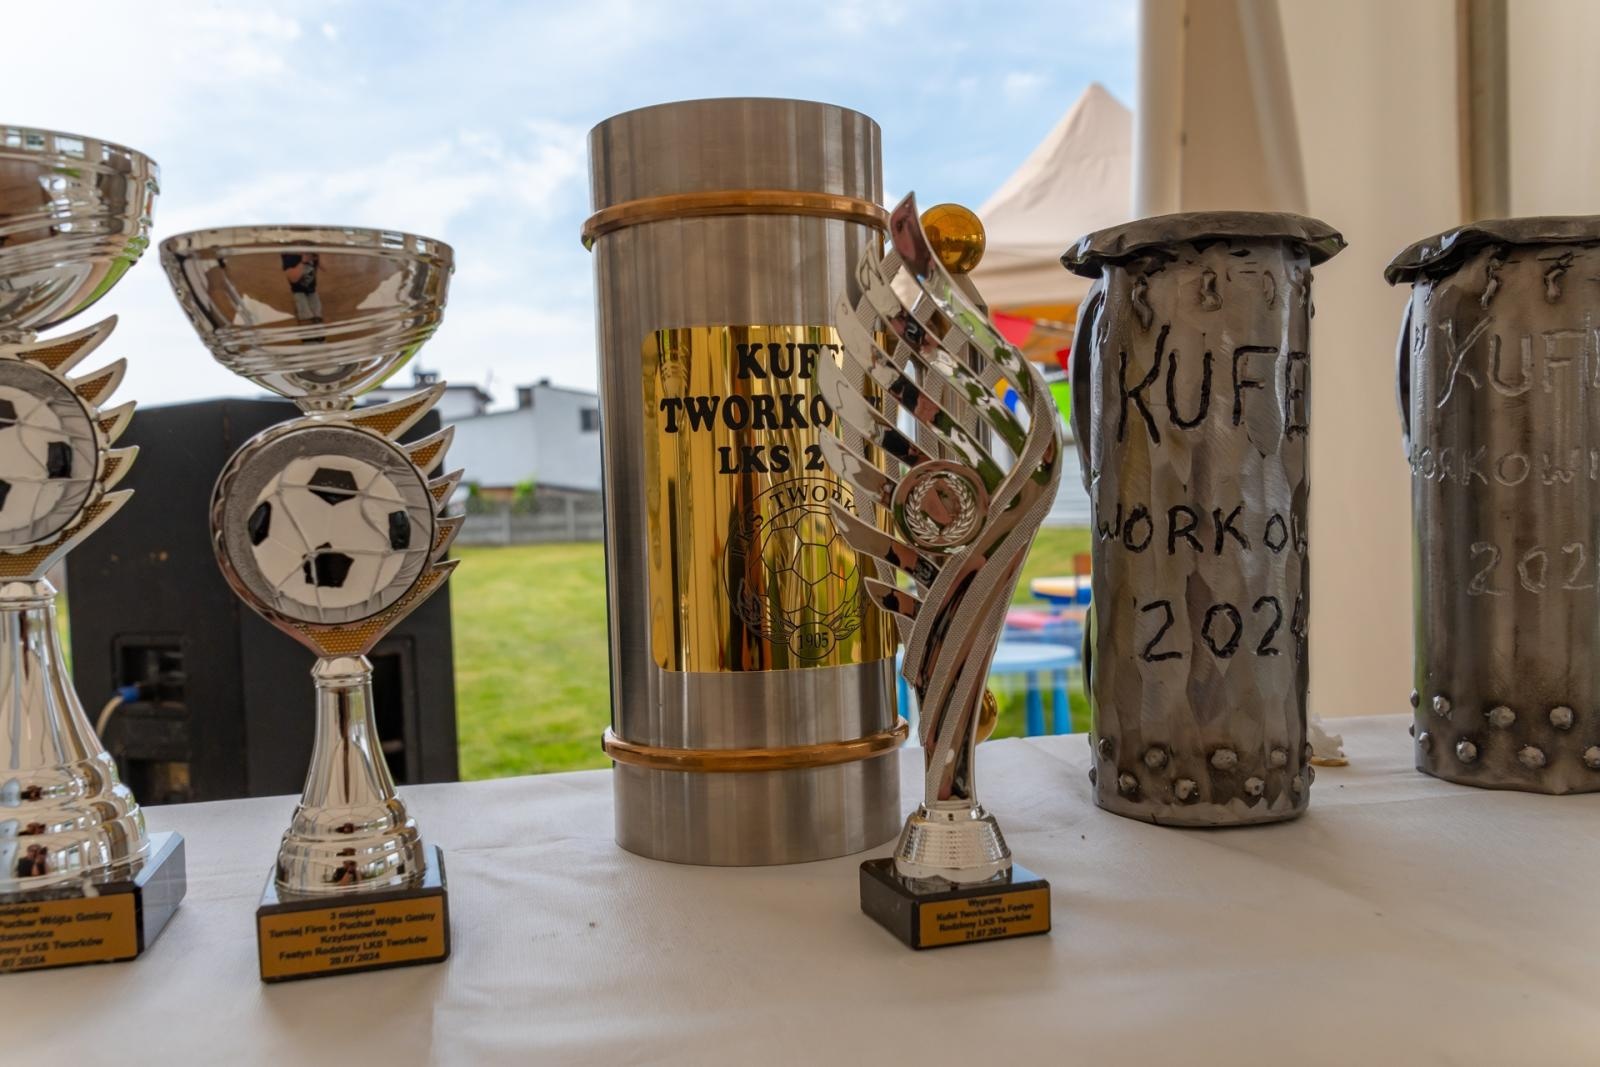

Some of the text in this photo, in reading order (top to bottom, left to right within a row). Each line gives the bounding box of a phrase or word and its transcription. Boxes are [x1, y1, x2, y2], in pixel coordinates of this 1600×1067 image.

[735, 342, 844, 380] KUF
[660, 393, 834, 433] TWORKO
[718, 444, 792, 475] LKS
[768, 484, 859, 517] TWORK
[1466, 541, 1594, 597] 202
[796, 631, 829, 649] 1905
[363, 939, 384, 951] LKS
